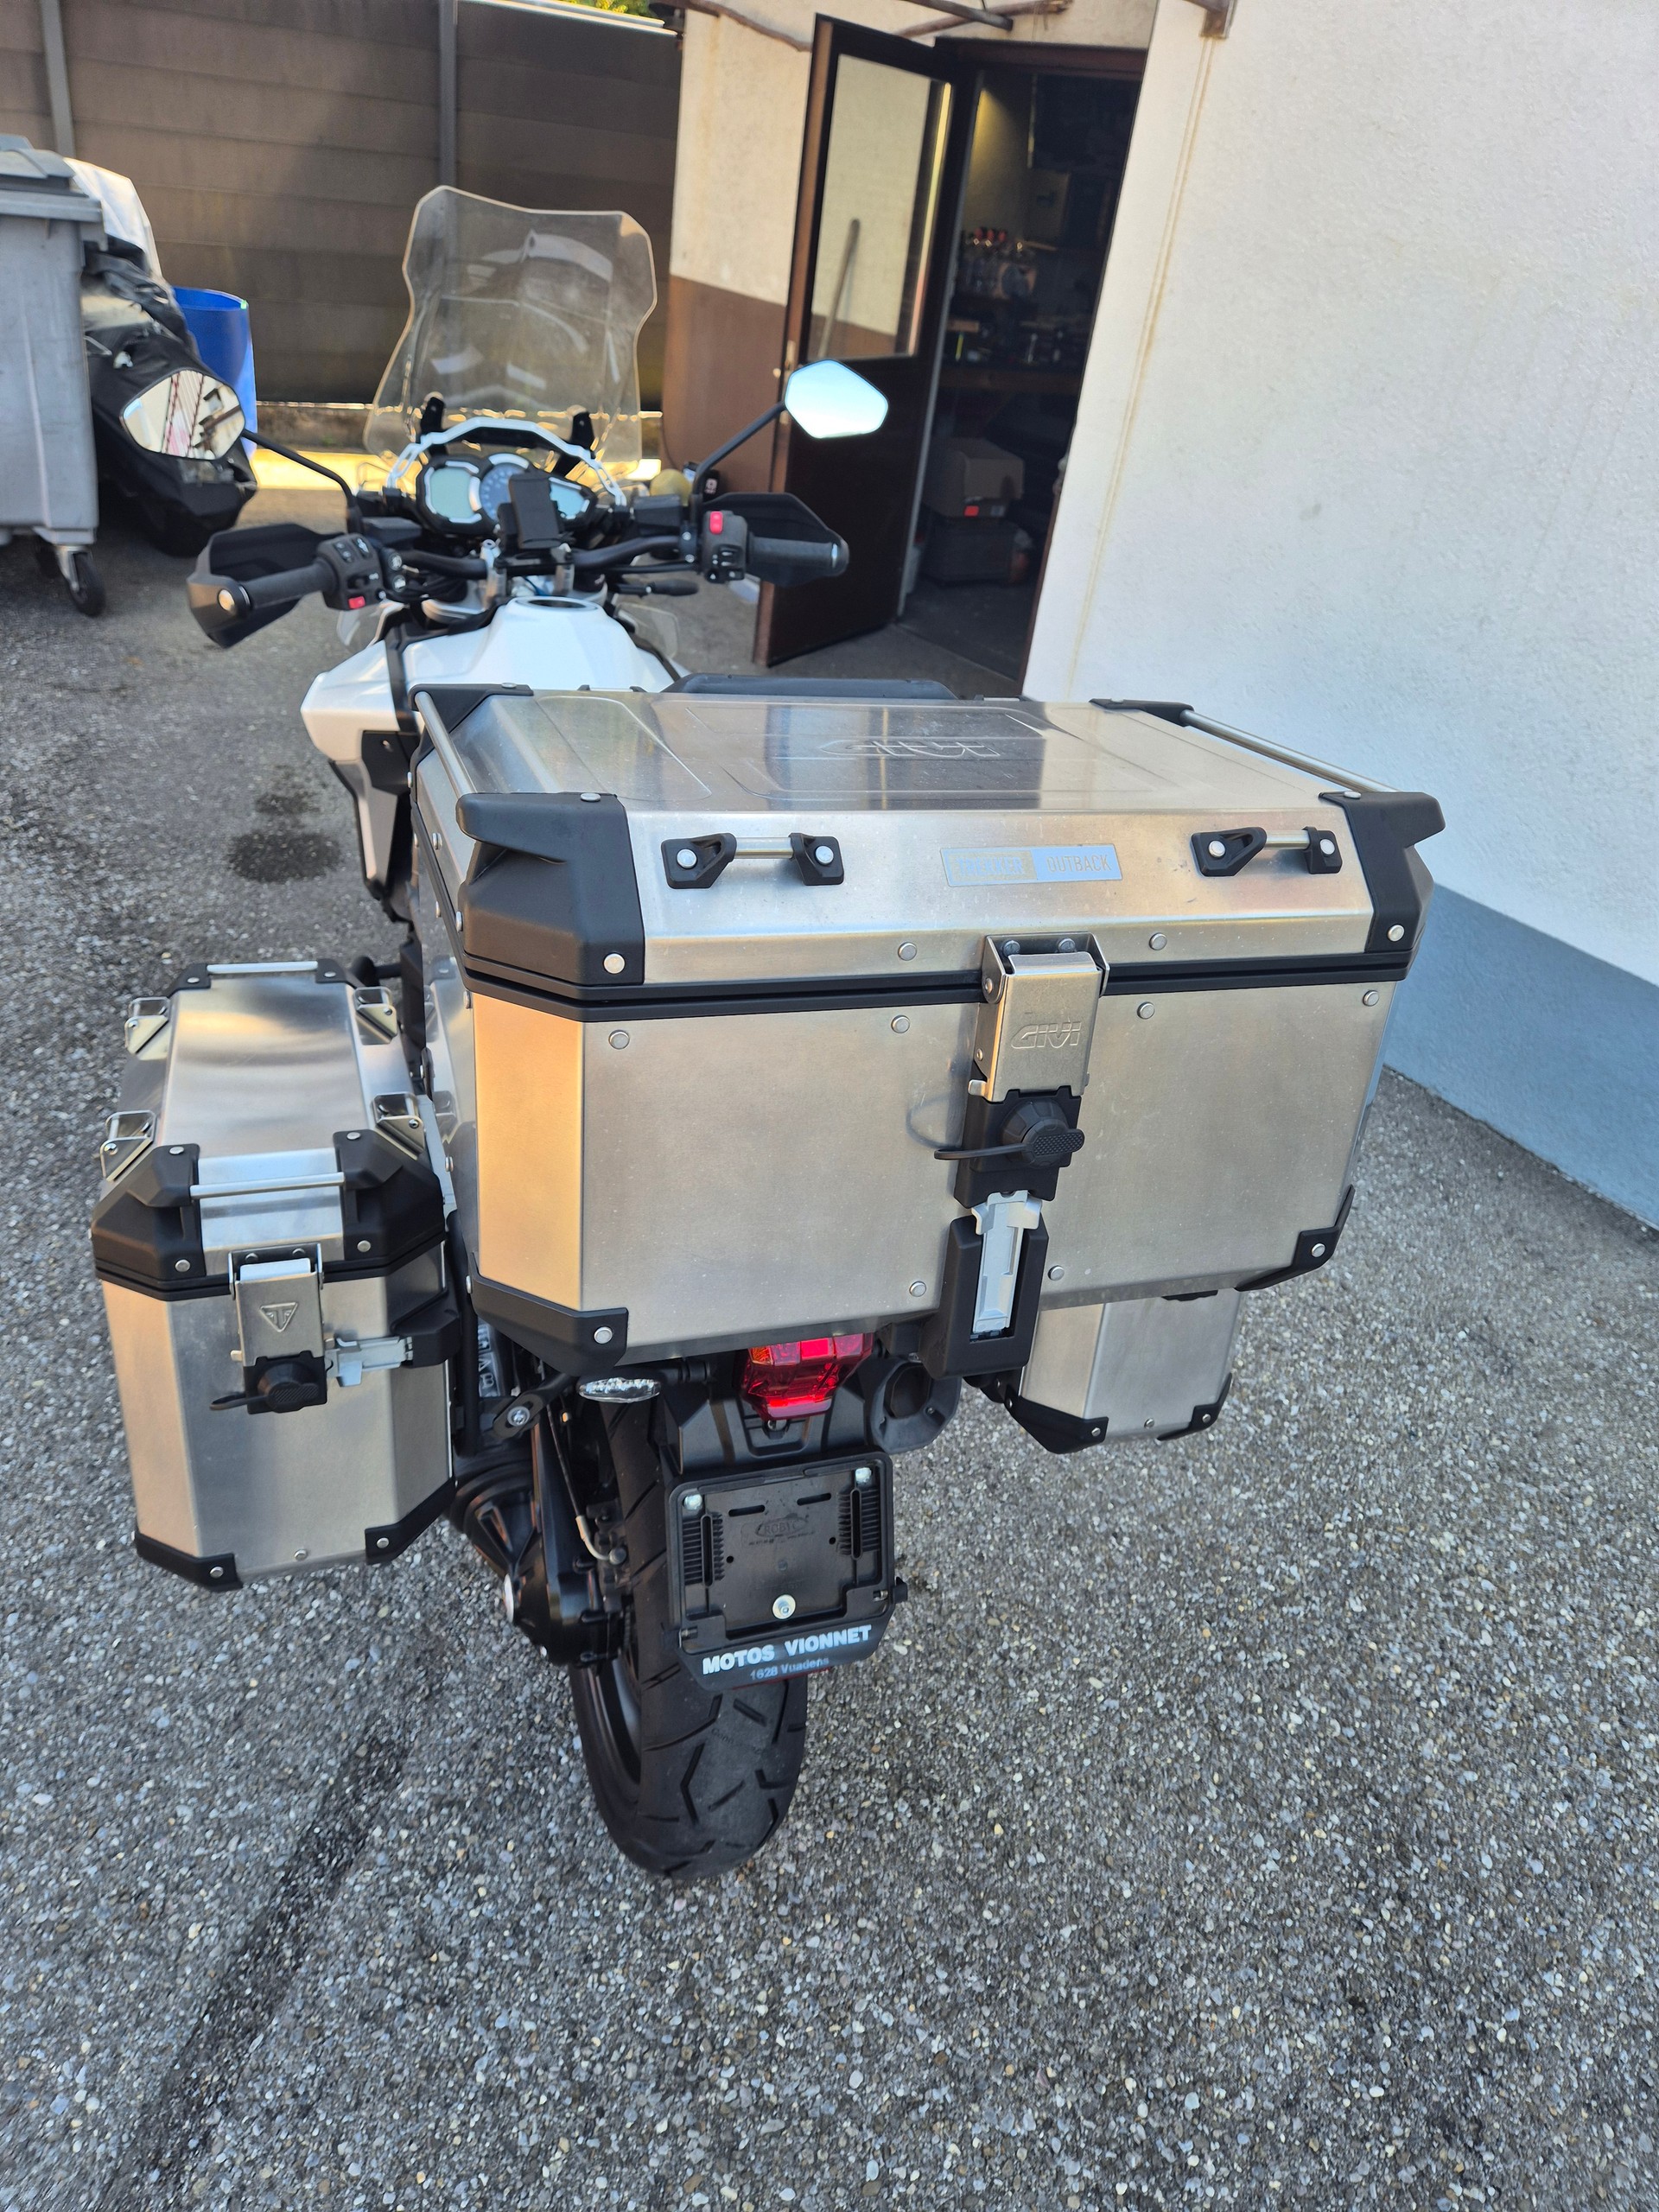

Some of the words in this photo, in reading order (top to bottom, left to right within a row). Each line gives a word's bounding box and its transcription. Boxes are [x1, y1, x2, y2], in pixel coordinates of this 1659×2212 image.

[1046, 855, 1111, 873] OUTBACK
[1010, 1020, 1082, 1050] GIVI
[702, 1643, 776, 1675] MOTOS
[784, 1624, 872, 1656] VIONNET
[749, 1665, 779, 1681] 1628
[780, 1657, 830, 1675] Vuadens
